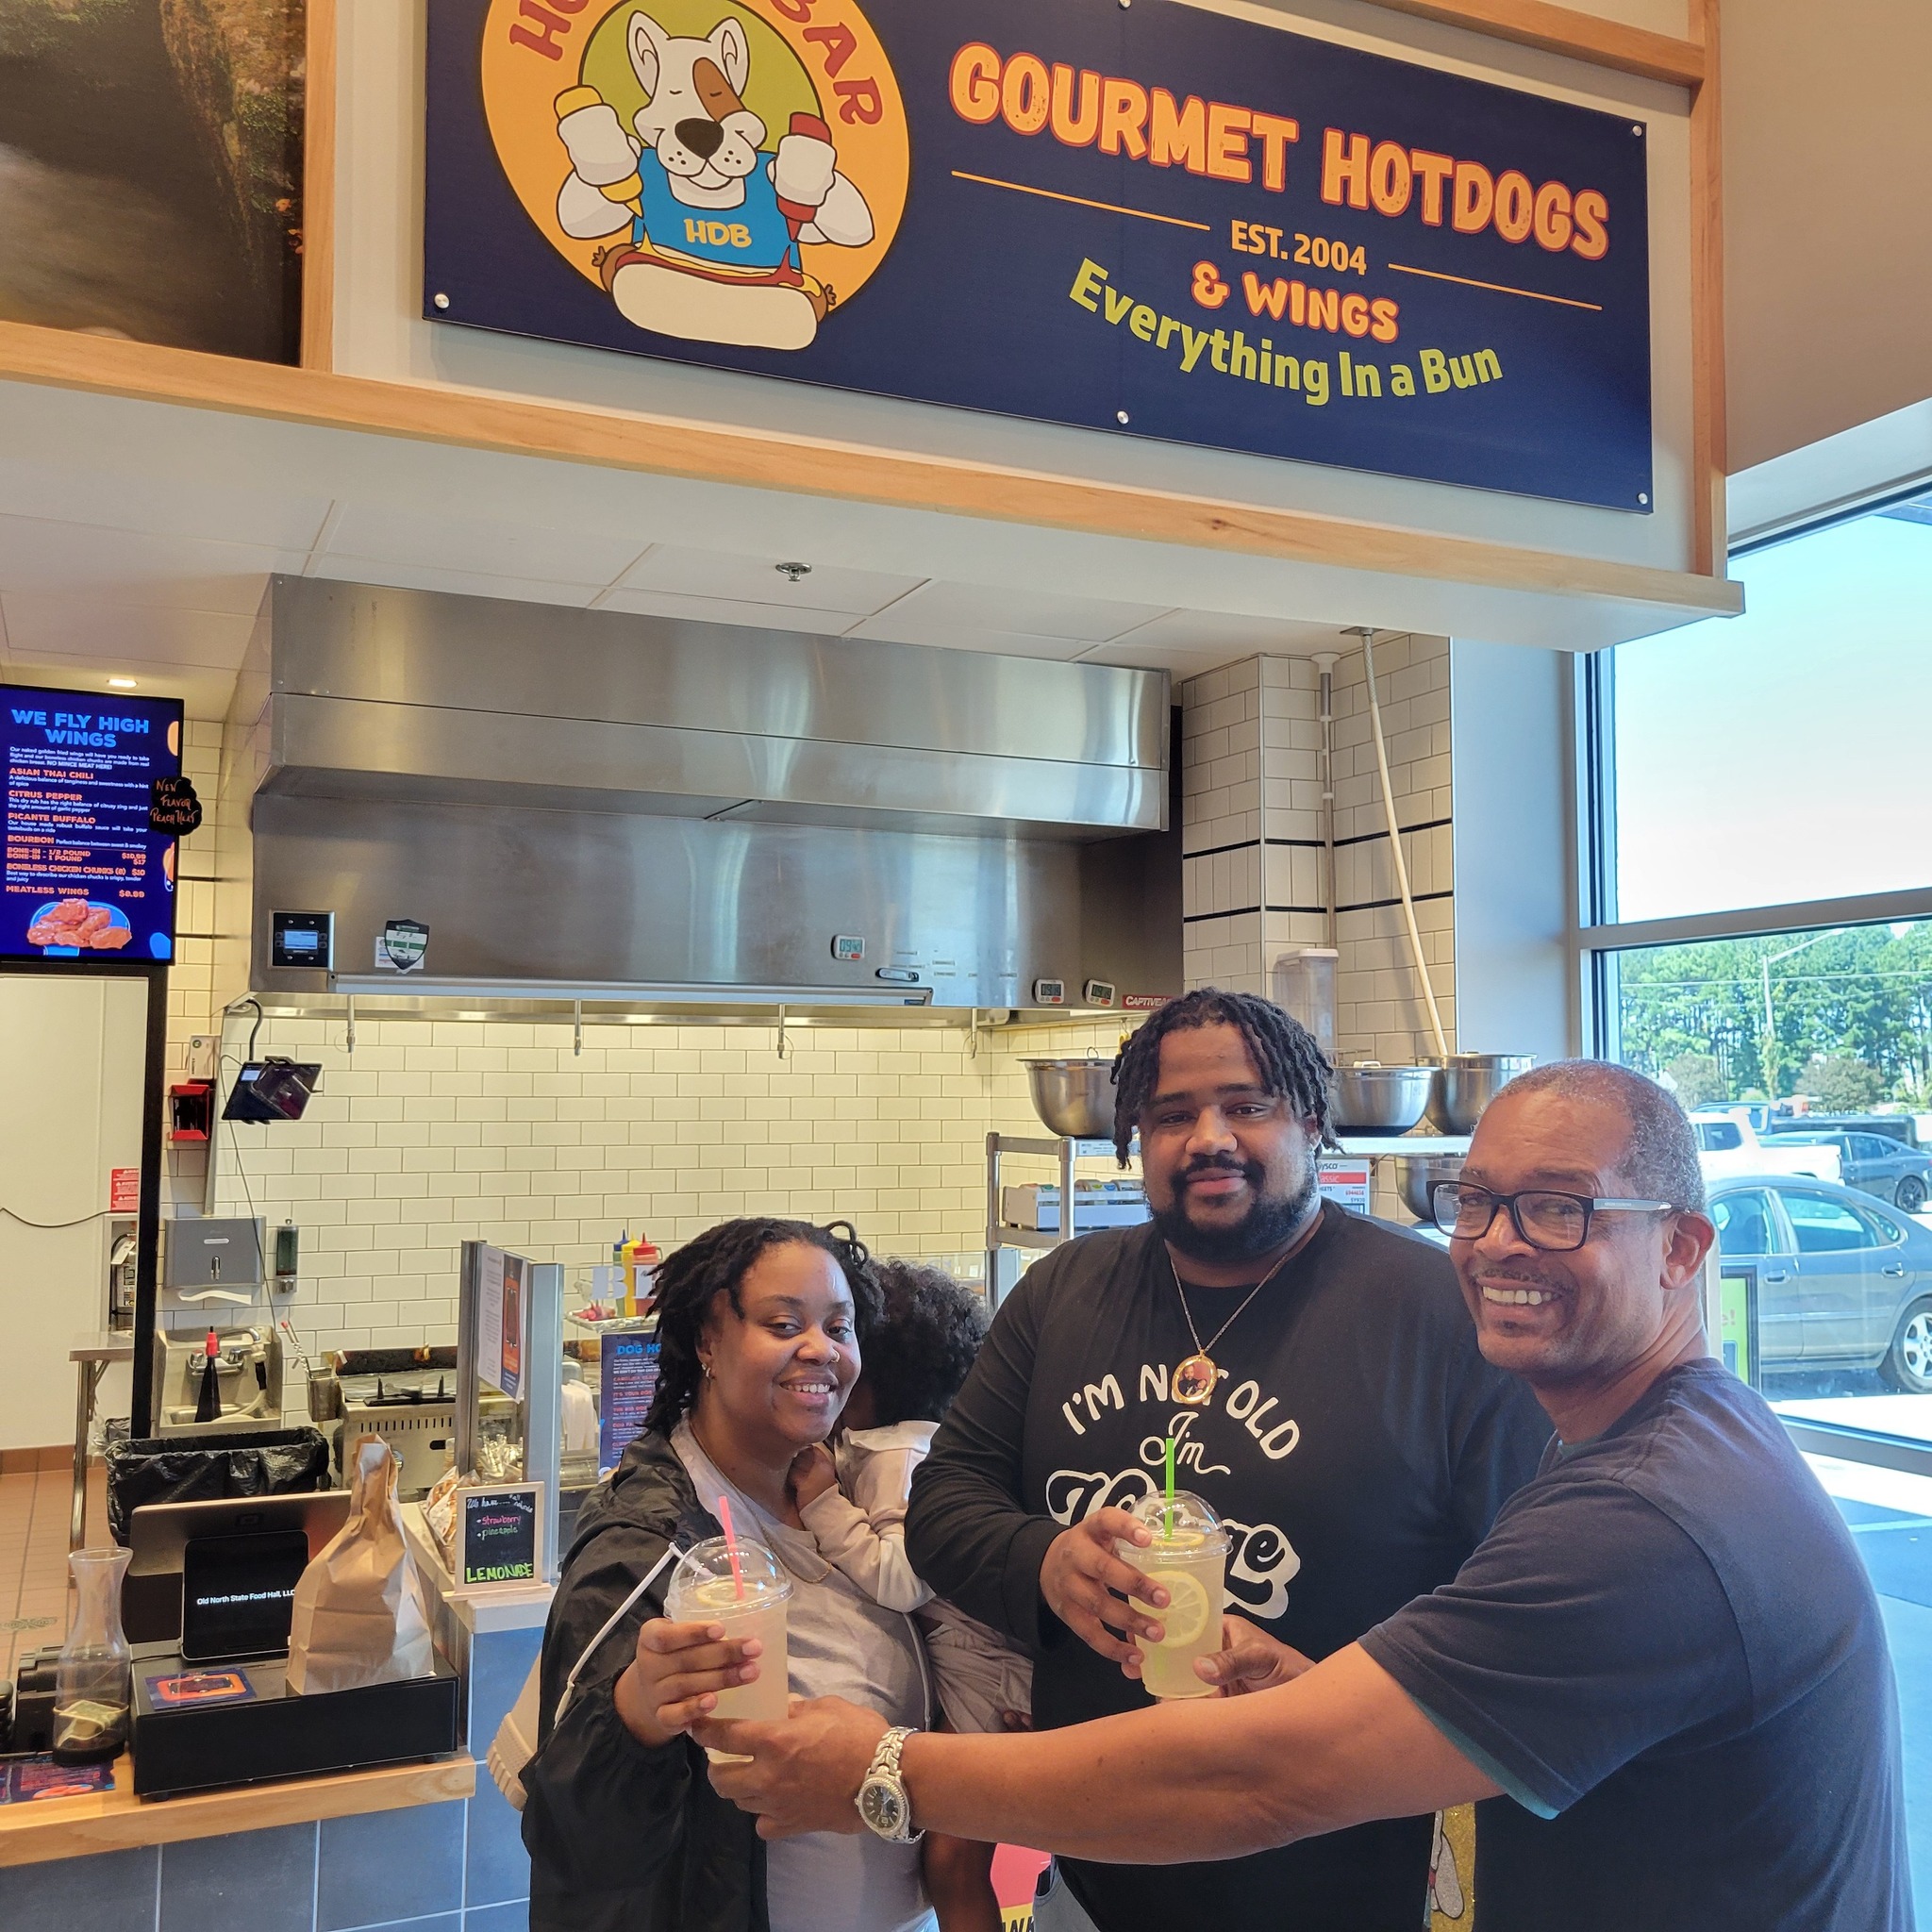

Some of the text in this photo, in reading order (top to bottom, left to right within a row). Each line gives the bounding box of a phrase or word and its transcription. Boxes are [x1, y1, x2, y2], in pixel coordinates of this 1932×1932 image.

[950, 42, 1610, 261] GOURMET HOTDOGS
[685, 218, 752, 248] HDB
[1231, 219, 1367, 275] EST. 2004
[1191, 260, 1400, 343] & WINGS
[1068, 257, 1504, 406] Everything In a Bun
[11, 709, 149, 733] WE FLY HIGH
[45, 729, 116, 747] WINGS
[46, 792, 82, 801] PEPPER
[53, 815, 95, 824] BUFFALO
[8, 835, 54, 843] BOURBON
[6, 886, 55, 894] MEATLESS
[617, 1344, 643, 1355] DOG
[1062, 1374, 1124, 1435] I'M
[1226, 1380, 1300, 1459] OLD
[466, 1562, 534, 1582] LEMONADE
[267, 1591, 282, 1599] Hall,
